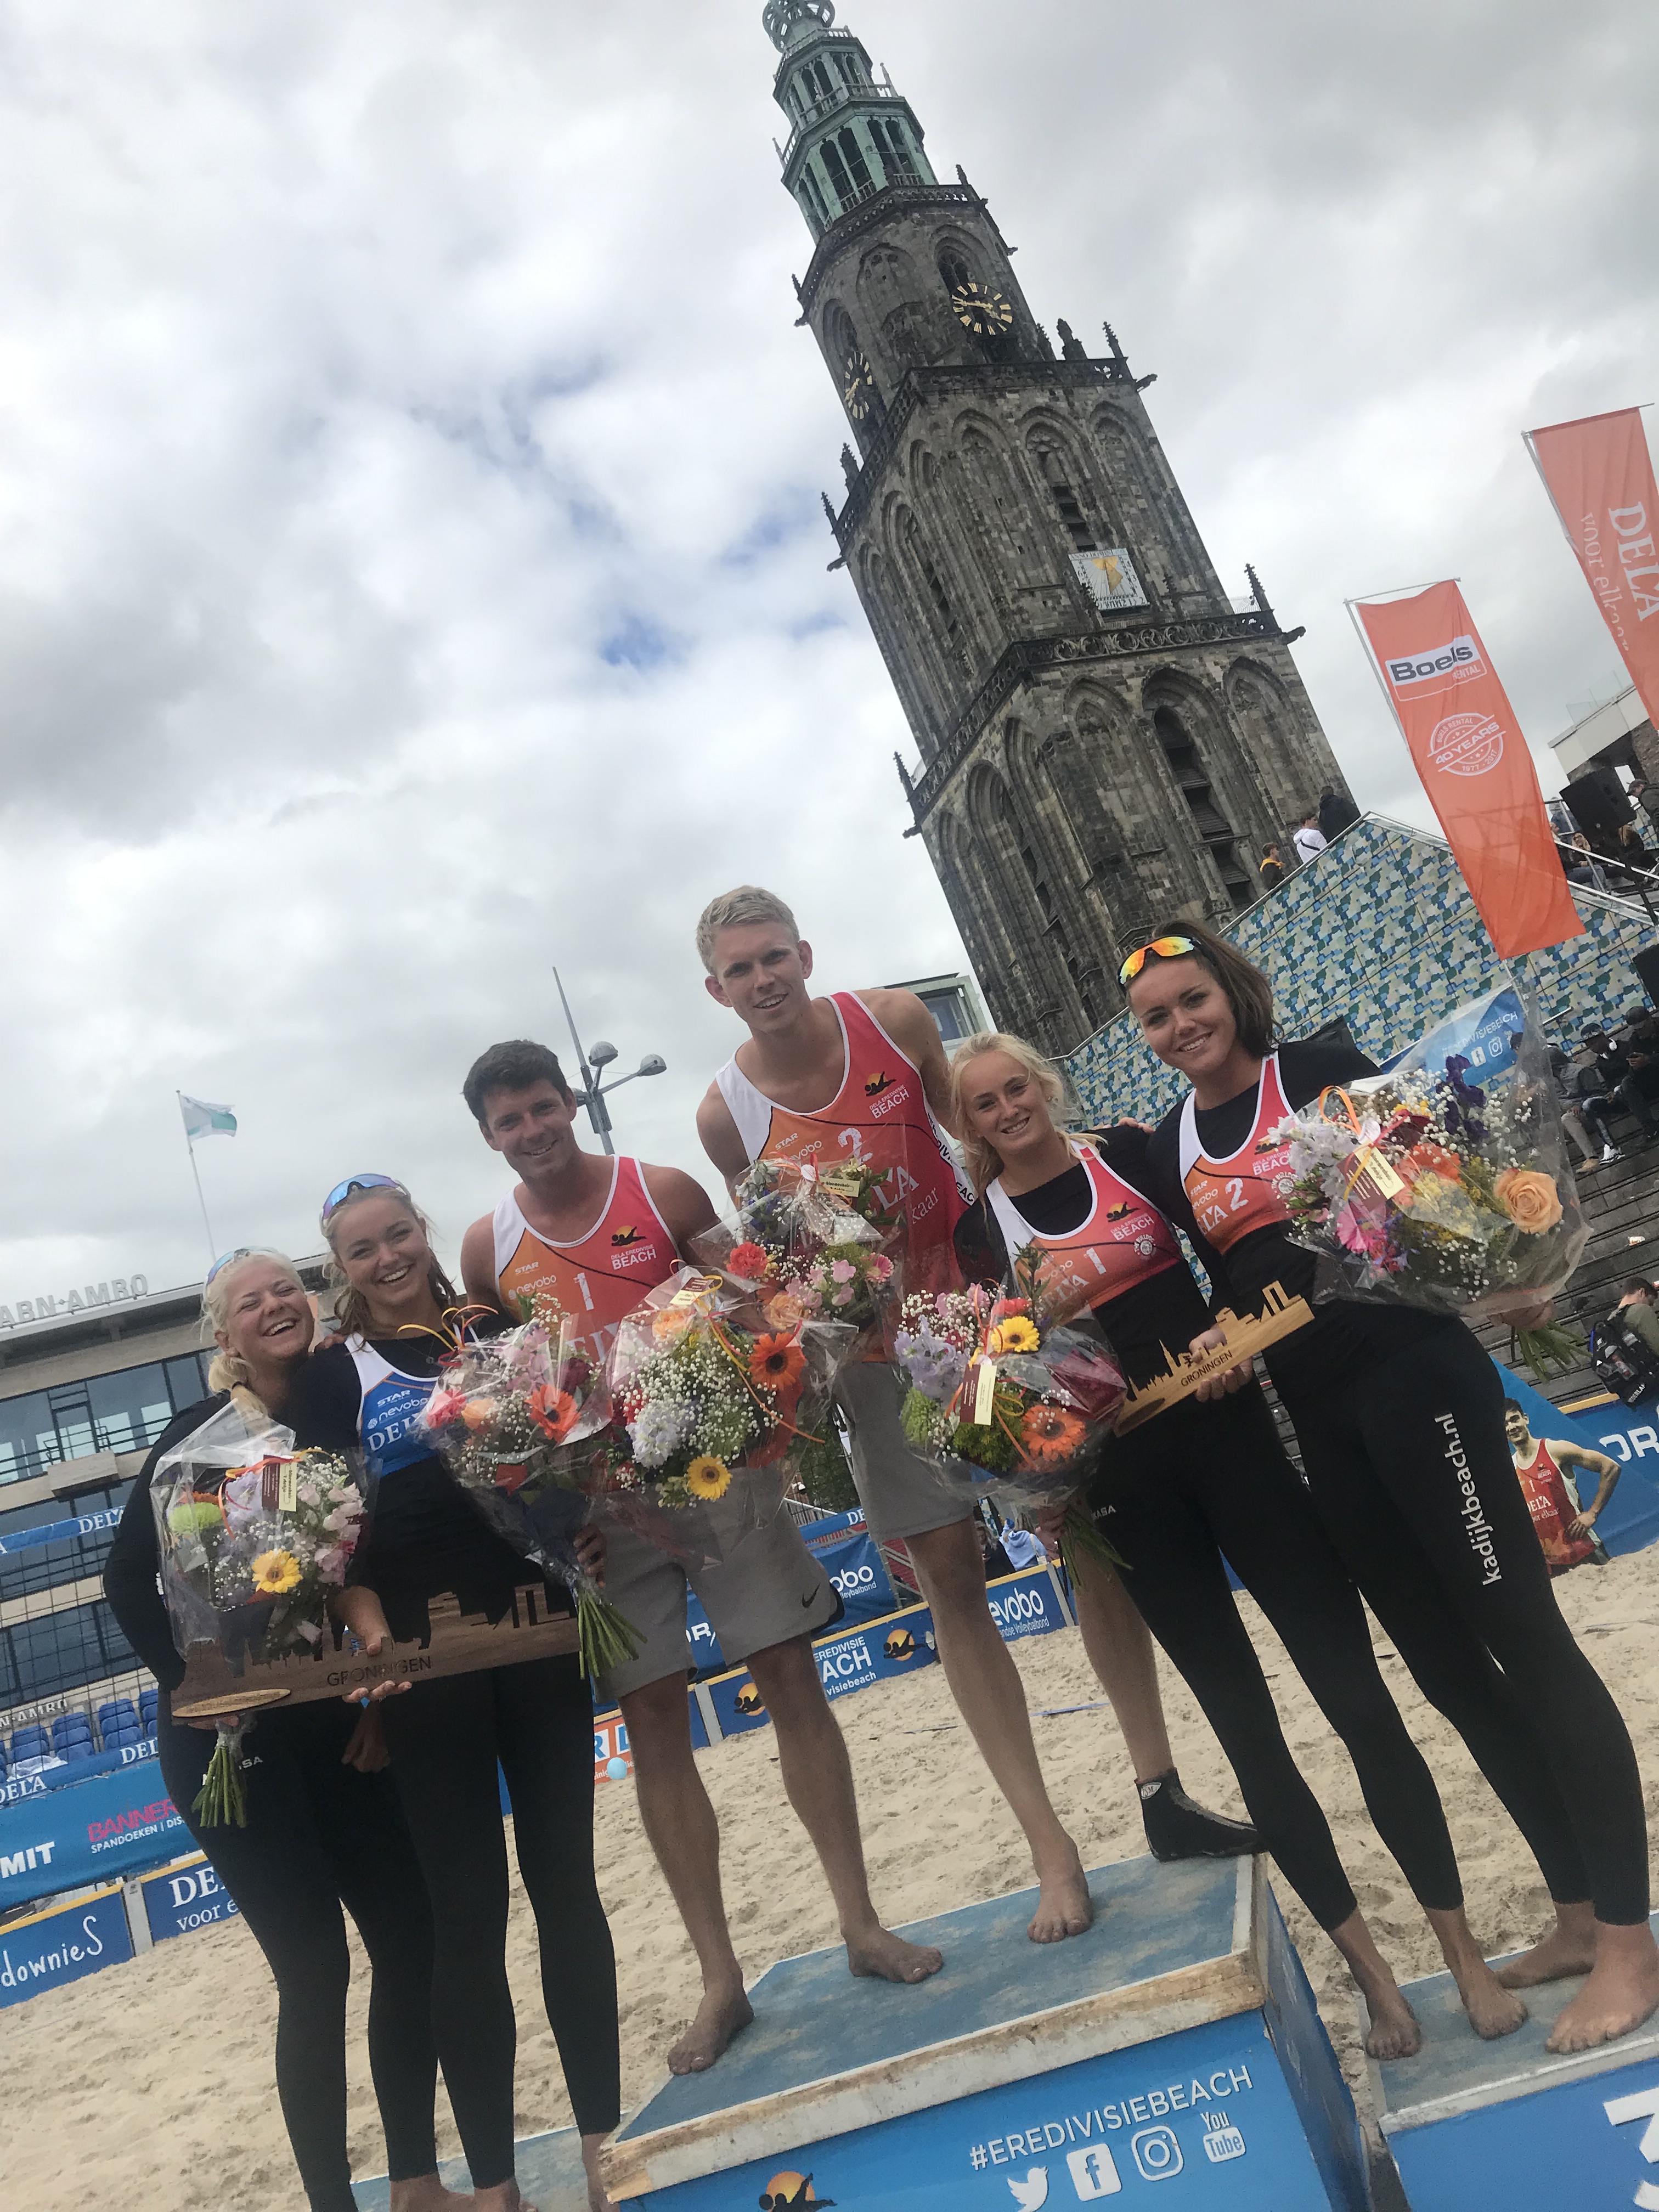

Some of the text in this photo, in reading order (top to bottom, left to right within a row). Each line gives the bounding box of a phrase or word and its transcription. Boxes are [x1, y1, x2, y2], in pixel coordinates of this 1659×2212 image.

[1581, 512, 1604, 568] voor
[1390, 646, 1474, 681] Boels
[1452, 664, 1481, 680] RENTAL
[1435, 721, 1500, 765] 40 YEARS
[1485, 749, 1498, 765] 2017
[871, 1088, 910, 1119] BEACH
[775, 1132, 799, 1150] STAR
[838, 1127, 873, 1167] 2
[1253, 1155, 1289, 1176] BEAC
[1225, 1177, 1249, 1211] 2
[1114, 1216, 1154, 1241] BEACH
[515, 1261, 539, 1275] STAR
[611, 1248, 657, 1271] BEACH
[1083, 1247, 1107, 1275] 1
[516, 1274, 557, 1294] nevobo
[573, 1272, 595, 1311] 1
[1181, 1349, 1233, 1387] GRONINGEN
[377, 1390, 411, 1406] STAR
[379, 1397, 428, 1422] nevobo
[1434, 1413, 1503, 1585] kadijkbeach.nl
[1528, 1479, 1536, 1493] 1
[1014, 1615, 1050, 1634] Volleybalbond
[327, 1655, 432, 1686] GRONINGEN
[88, 1798, 179, 1843] BANNER
[91, 1824, 158, 1854] SPANDOEKEN
[168, 1866, 226, 1908] DE
[177, 1904, 221, 1931] voor
[969, 2065, 1254, 2171] #EREDIVISIEBEACH
[1200, 2111, 1230, 2132] You
[1205, 2133, 1243, 2160] Tube
